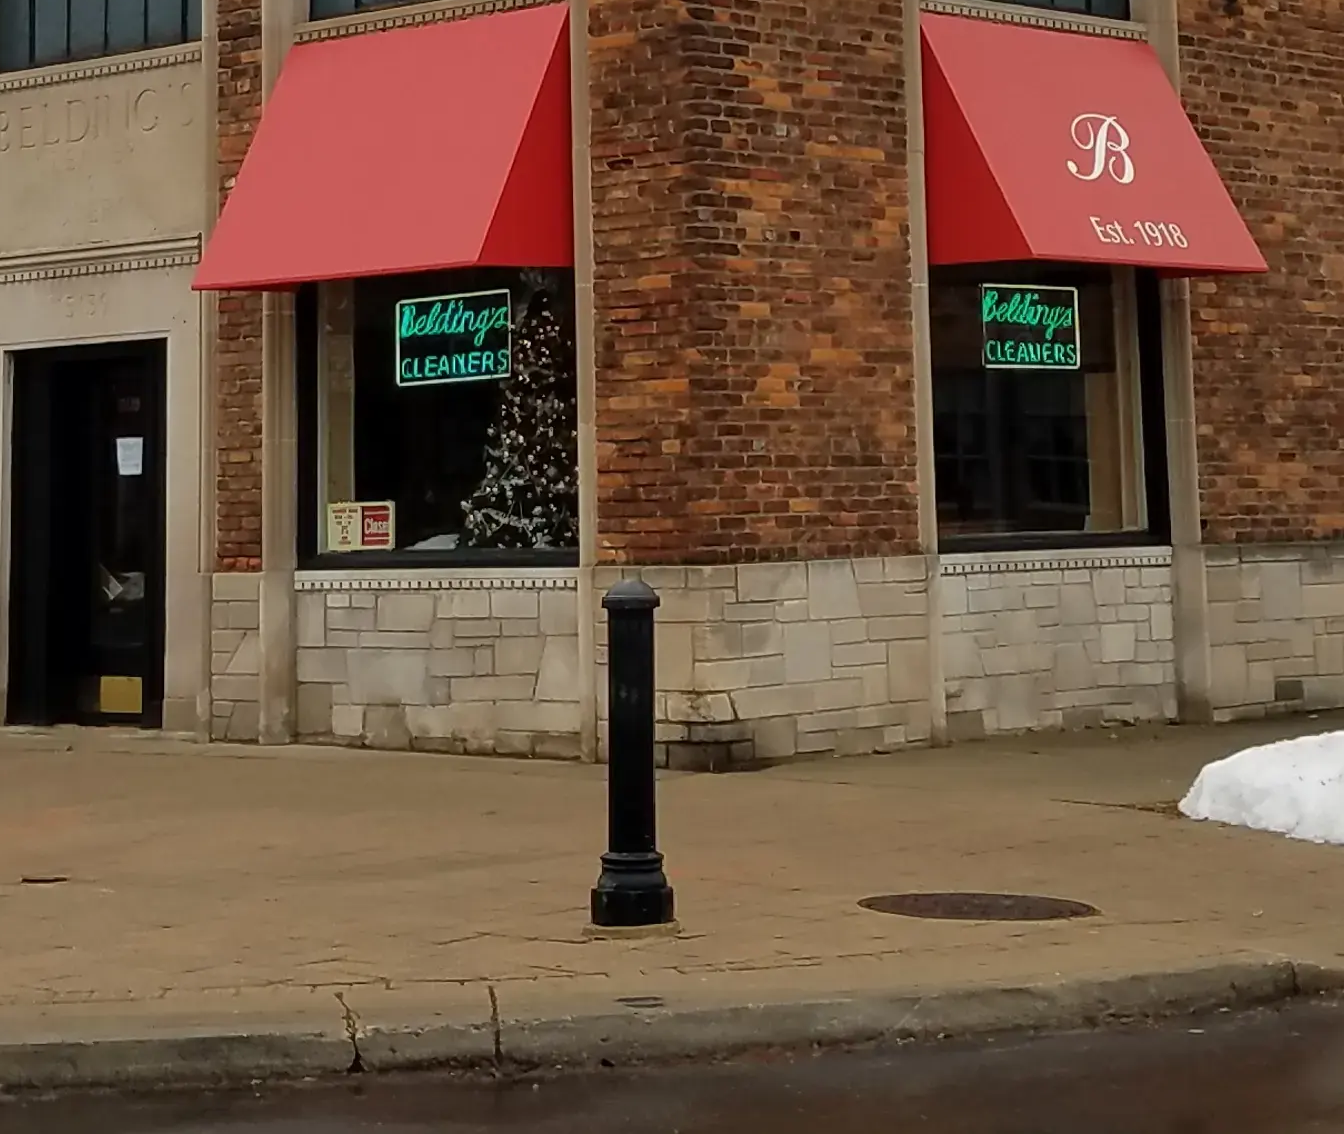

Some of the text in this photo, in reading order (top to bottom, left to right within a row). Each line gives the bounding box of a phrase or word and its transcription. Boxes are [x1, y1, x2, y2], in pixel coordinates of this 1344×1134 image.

[1067, 113, 1135, 184] B
[1090, 216, 1188, 248] Est. 1918
[401, 300, 508, 346] Belding's
[402, 349, 508, 378] CLEANERS
[987, 340, 1076, 364] CLEANERS
